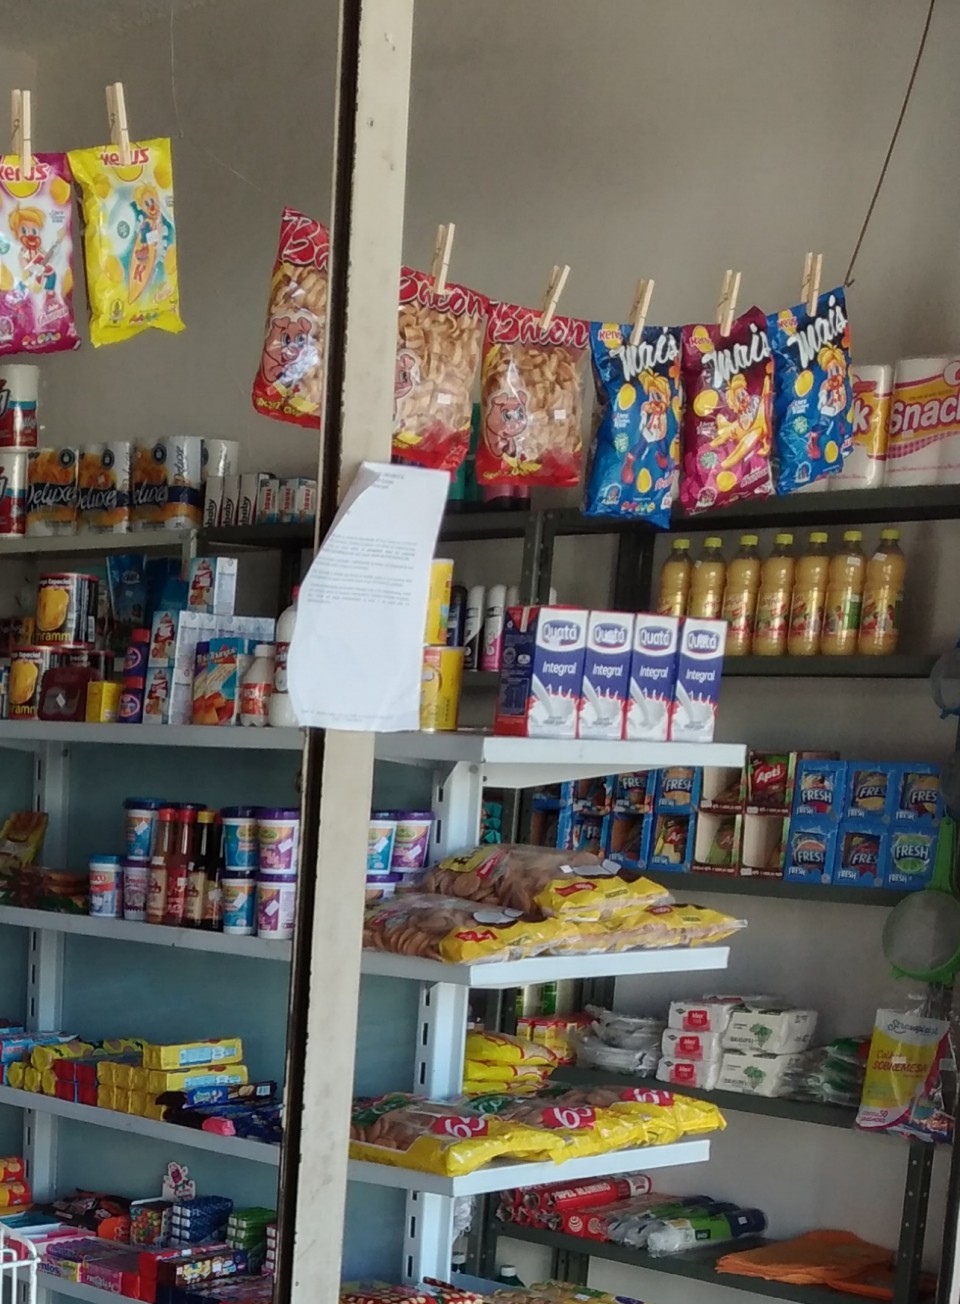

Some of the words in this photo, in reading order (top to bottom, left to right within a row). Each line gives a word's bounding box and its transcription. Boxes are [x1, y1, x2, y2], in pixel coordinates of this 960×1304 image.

[100, 147, 150, 167] Keus
[133, 264, 147, 283] K
[488, 300, 589, 348] Bacon
[888, 393, 960, 436] Snac
[542, 624, 578, 642] Quatá
[640, 630, 671, 646] Quatá
[542, 661, 577, 677] Integral
[592, 663, 624, 678] Integral
[639, 665, 669, 680] Integral
[685, 668, 716, 683] Integral
[757, 766, 783, 784] Apti
[802, 789, 832, 804] FRESH
[859, 786, 885, 798] FRES
[911, 789, 937, 803] FRES
[851, 852, 878, 866] FRES
[895, 844, 929, 860] FRESH
